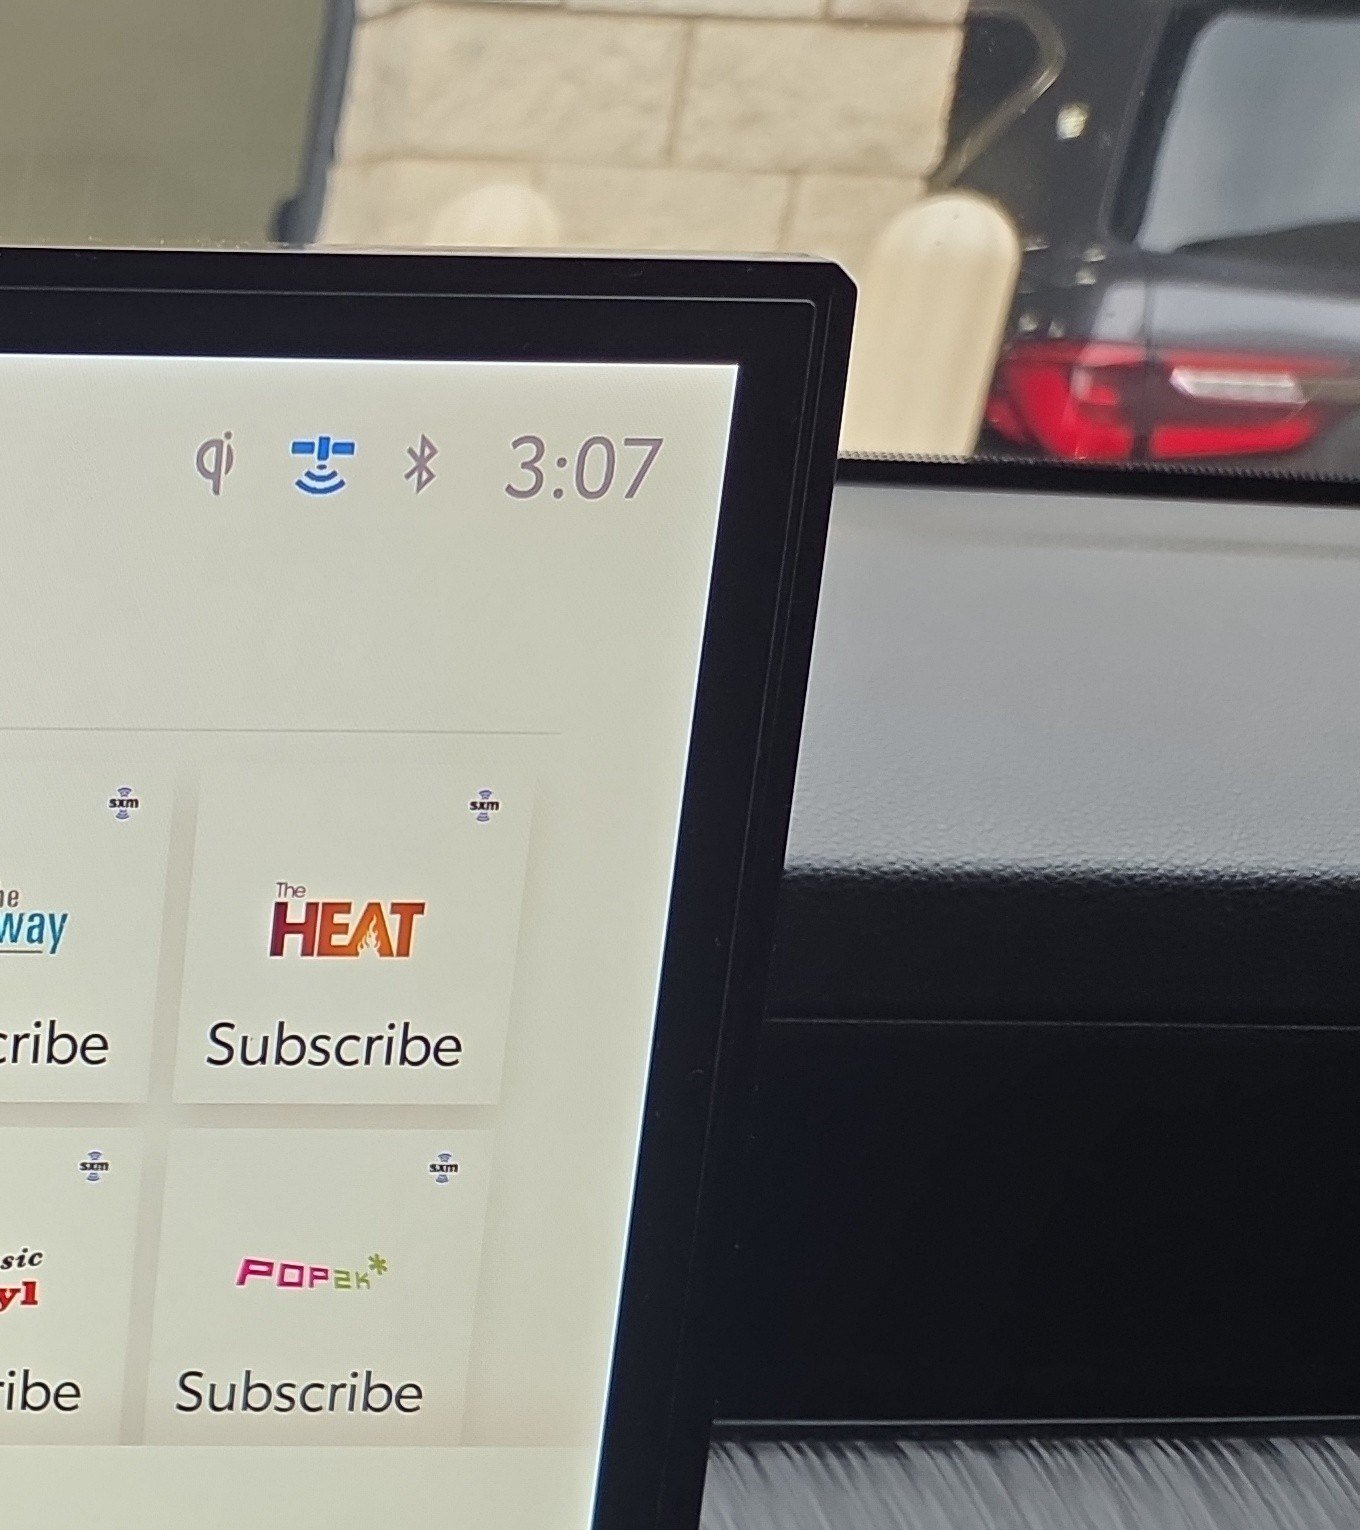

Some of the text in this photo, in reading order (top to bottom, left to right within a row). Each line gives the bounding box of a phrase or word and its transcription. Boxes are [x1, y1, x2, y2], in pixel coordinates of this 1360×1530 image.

[505, 436, 663, 499] 3:07
[276, 881, 307, 899] The
[269, 901, 426, 958] HEAT
[207, 1021, 461, 1066] Subscribe
[177, 1370, 422, 1412] Subscribe
